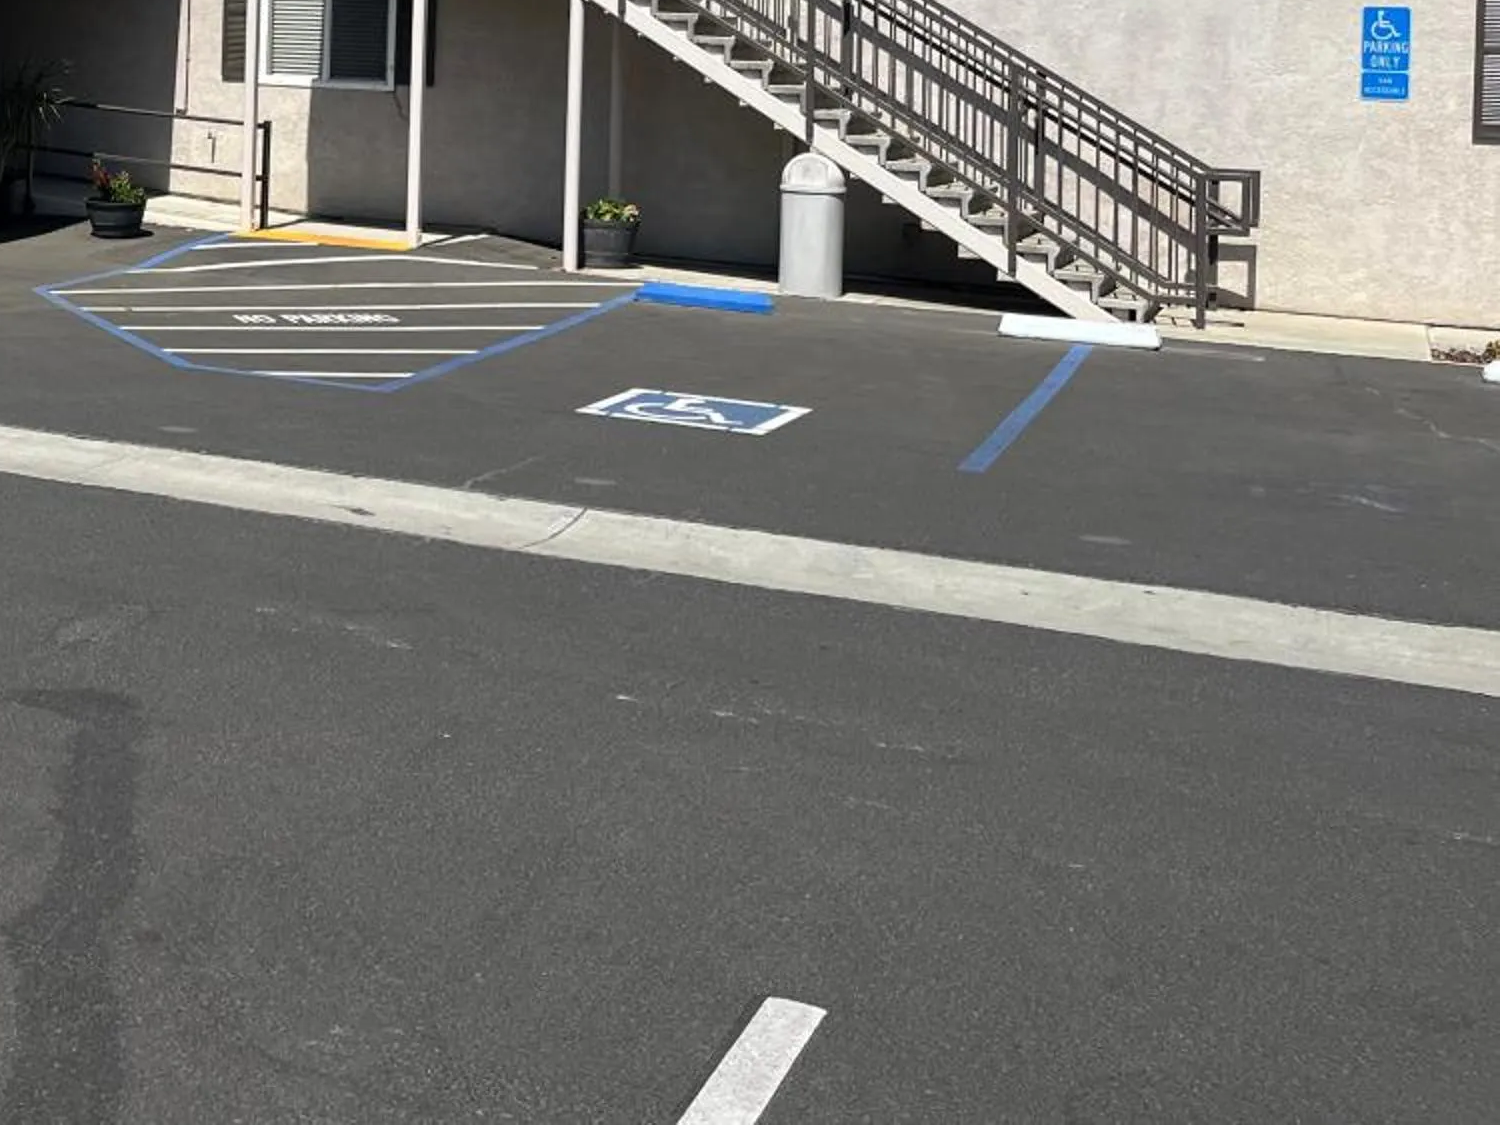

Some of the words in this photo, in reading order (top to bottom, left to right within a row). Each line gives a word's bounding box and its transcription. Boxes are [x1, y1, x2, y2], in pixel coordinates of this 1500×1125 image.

[1363, 40, 1409, 54] PARKING
[1370, 55, 1401, 69] ONLY
[232, 314, 276, 324] NO
[279, 313, 400, 324] PARKING
